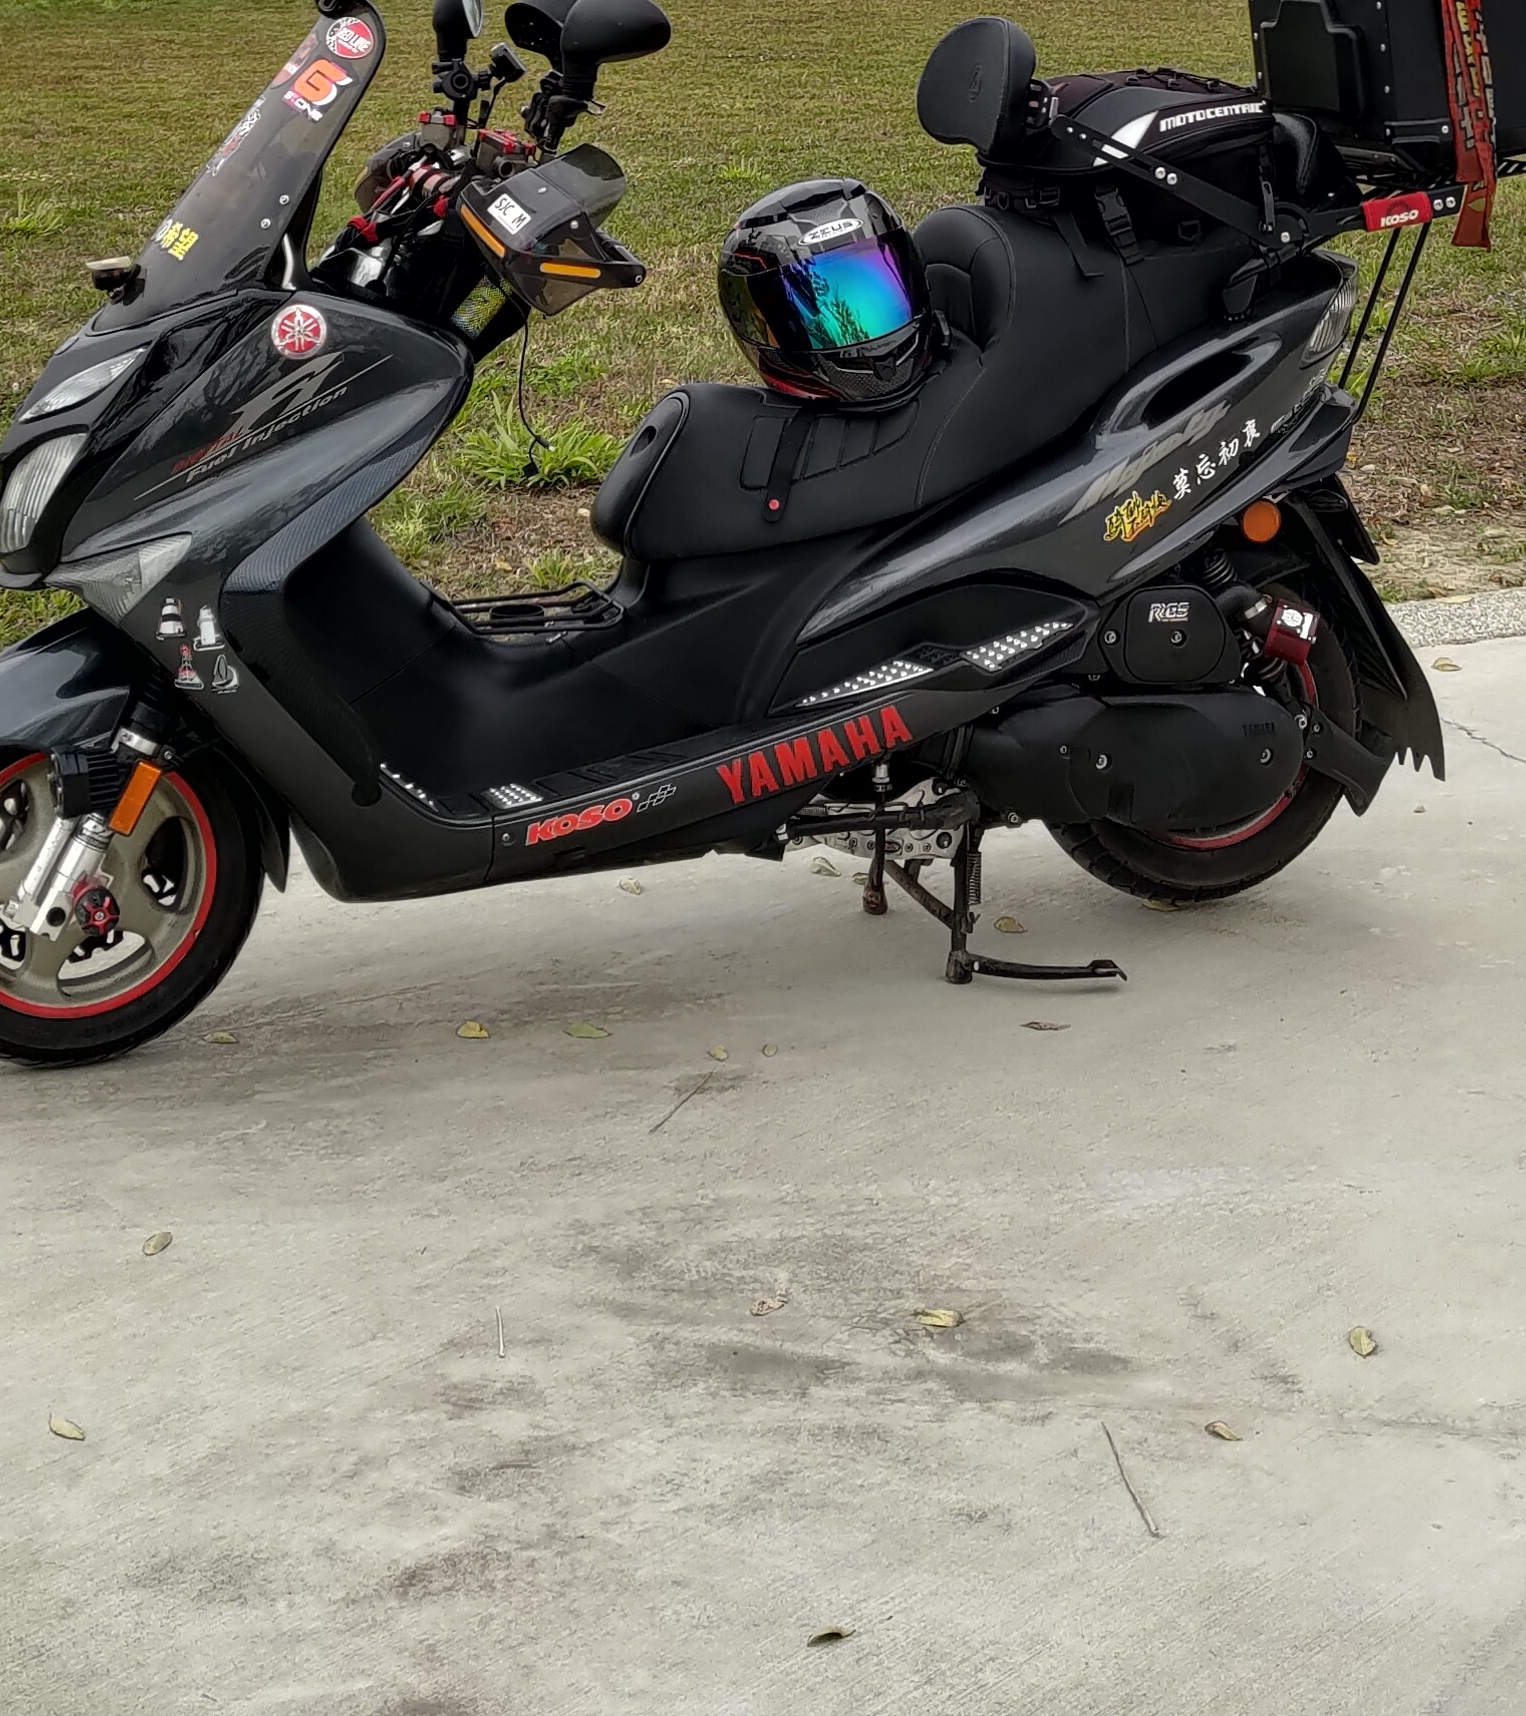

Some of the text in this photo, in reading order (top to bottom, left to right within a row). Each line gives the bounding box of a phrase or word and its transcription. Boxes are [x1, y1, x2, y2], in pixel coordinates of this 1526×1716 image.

[1159, 101, 1265, 133] MOTOCENTRIC
[1380, 209, 1419, 227] KOSO
[185, 386, 348, 484] Fuel Injection
[716, 704, 913, 805] YAMAHA
[524, 797, 633, 847] KOSO
